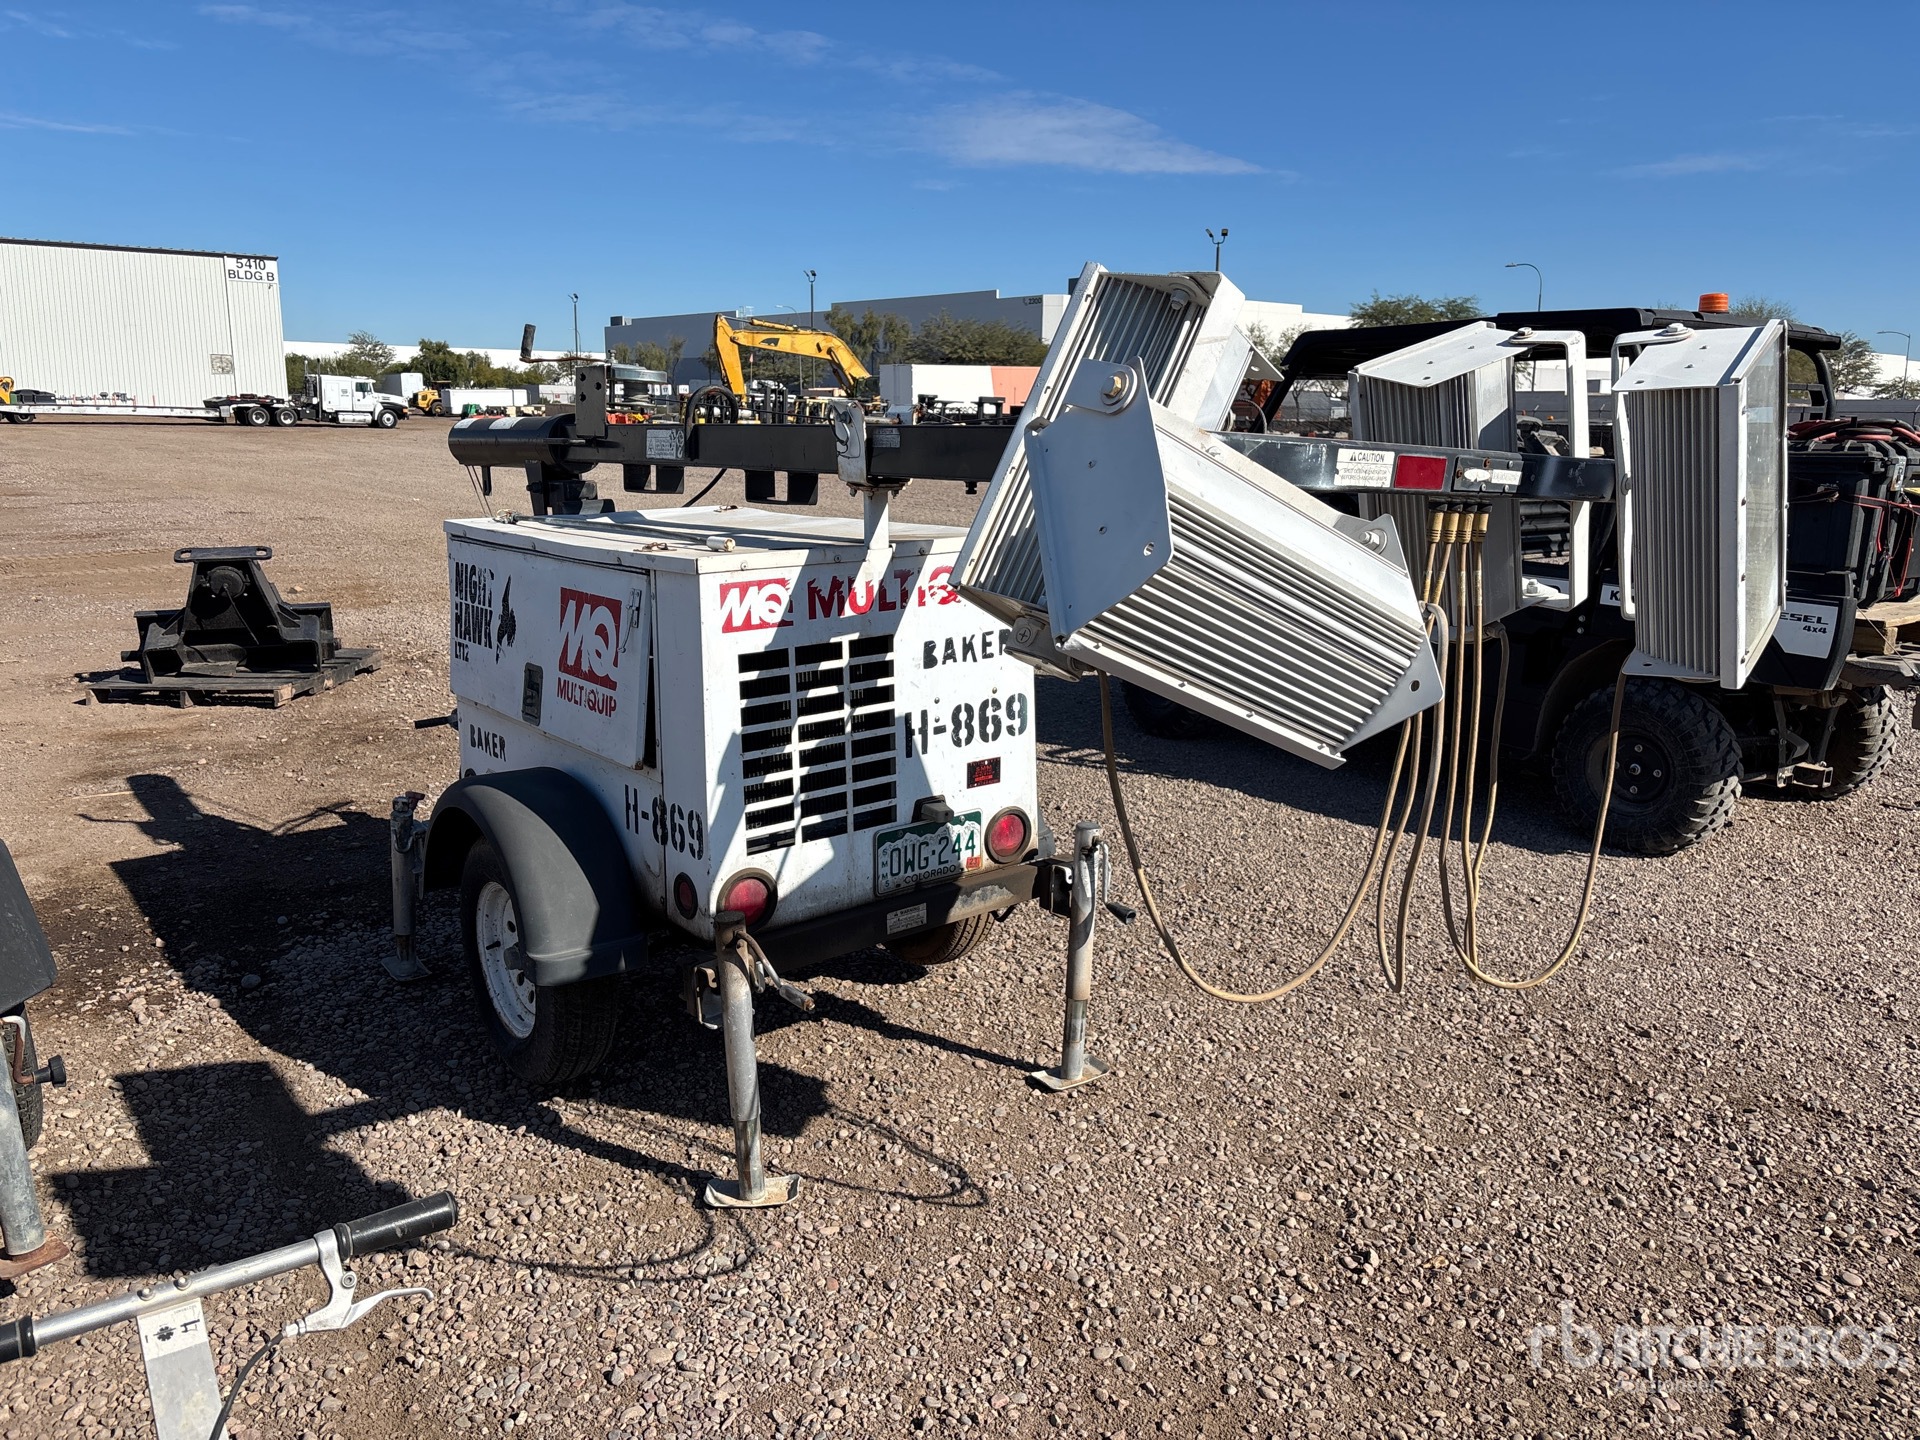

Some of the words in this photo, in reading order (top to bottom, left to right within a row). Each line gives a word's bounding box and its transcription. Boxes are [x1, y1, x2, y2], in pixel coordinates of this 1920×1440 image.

[236, 258, 266, 270] 5410
[266, 272, 275, 281] B
[1357, 452, 1385, 462] CAUTION
[455, 601, 493, 649] HAWK
[721, 581, 791, 629] MQ
[559, 597, 620, 680] MQ
[469, 724, 506, 762] BAKER
[904, 692, 1028, 758] H-869
[624, 784, 704, 861] H-869
[903, 864, 956, 884] COLORADO
